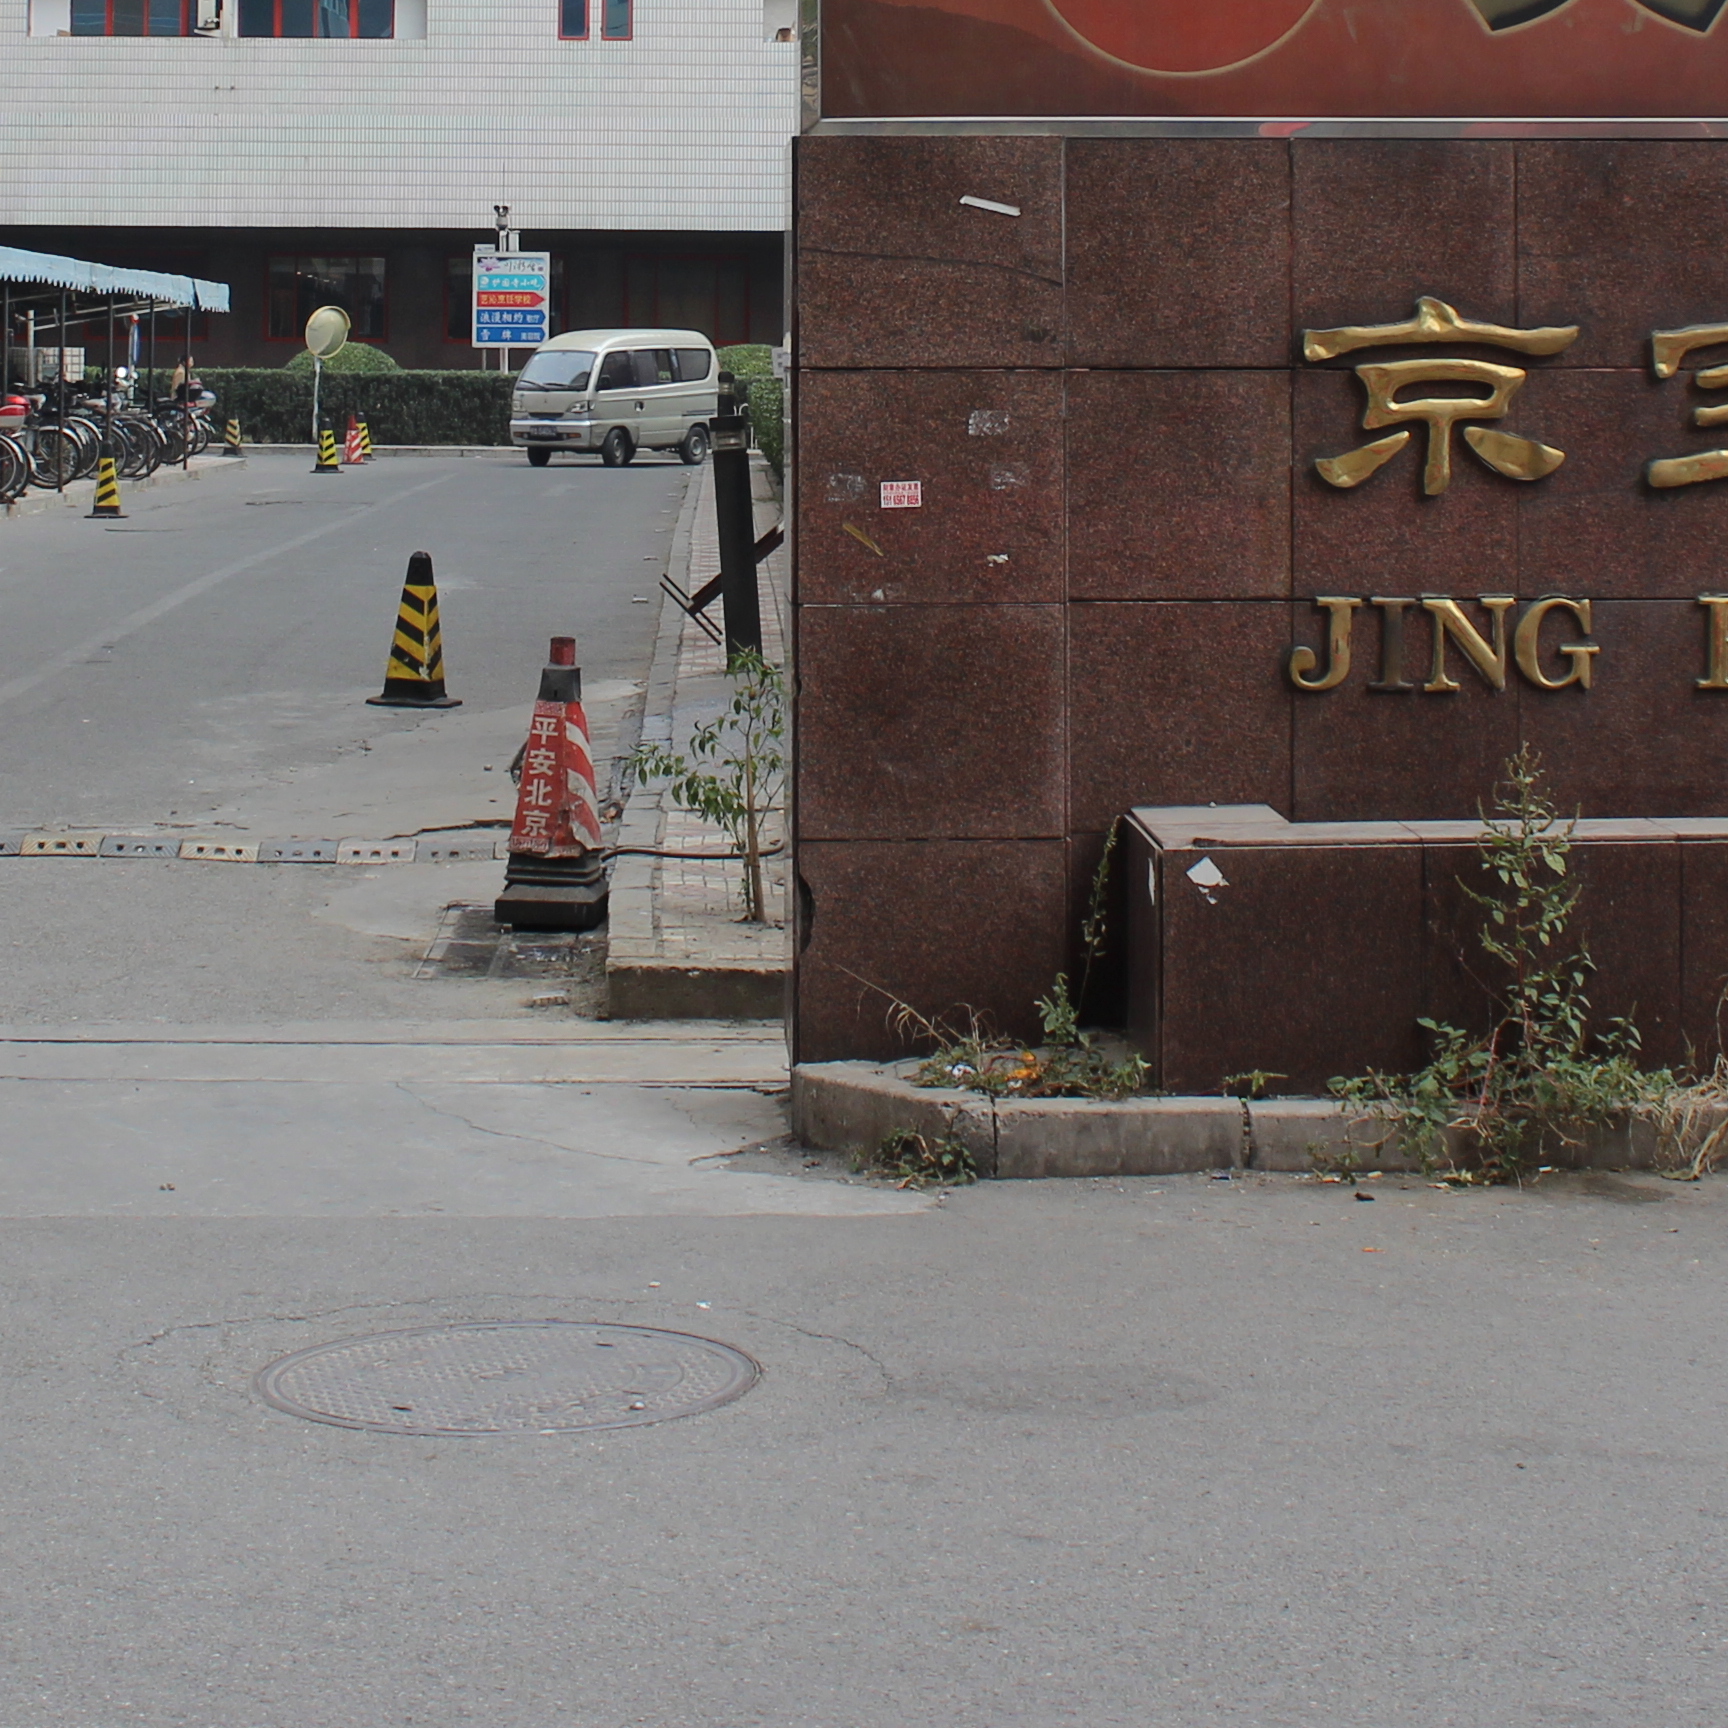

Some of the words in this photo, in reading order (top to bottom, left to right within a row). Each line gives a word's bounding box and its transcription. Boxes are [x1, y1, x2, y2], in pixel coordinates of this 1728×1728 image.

[1289, 590, 1598, 694] JING
[521, 716, 559, 837] 平安北京
